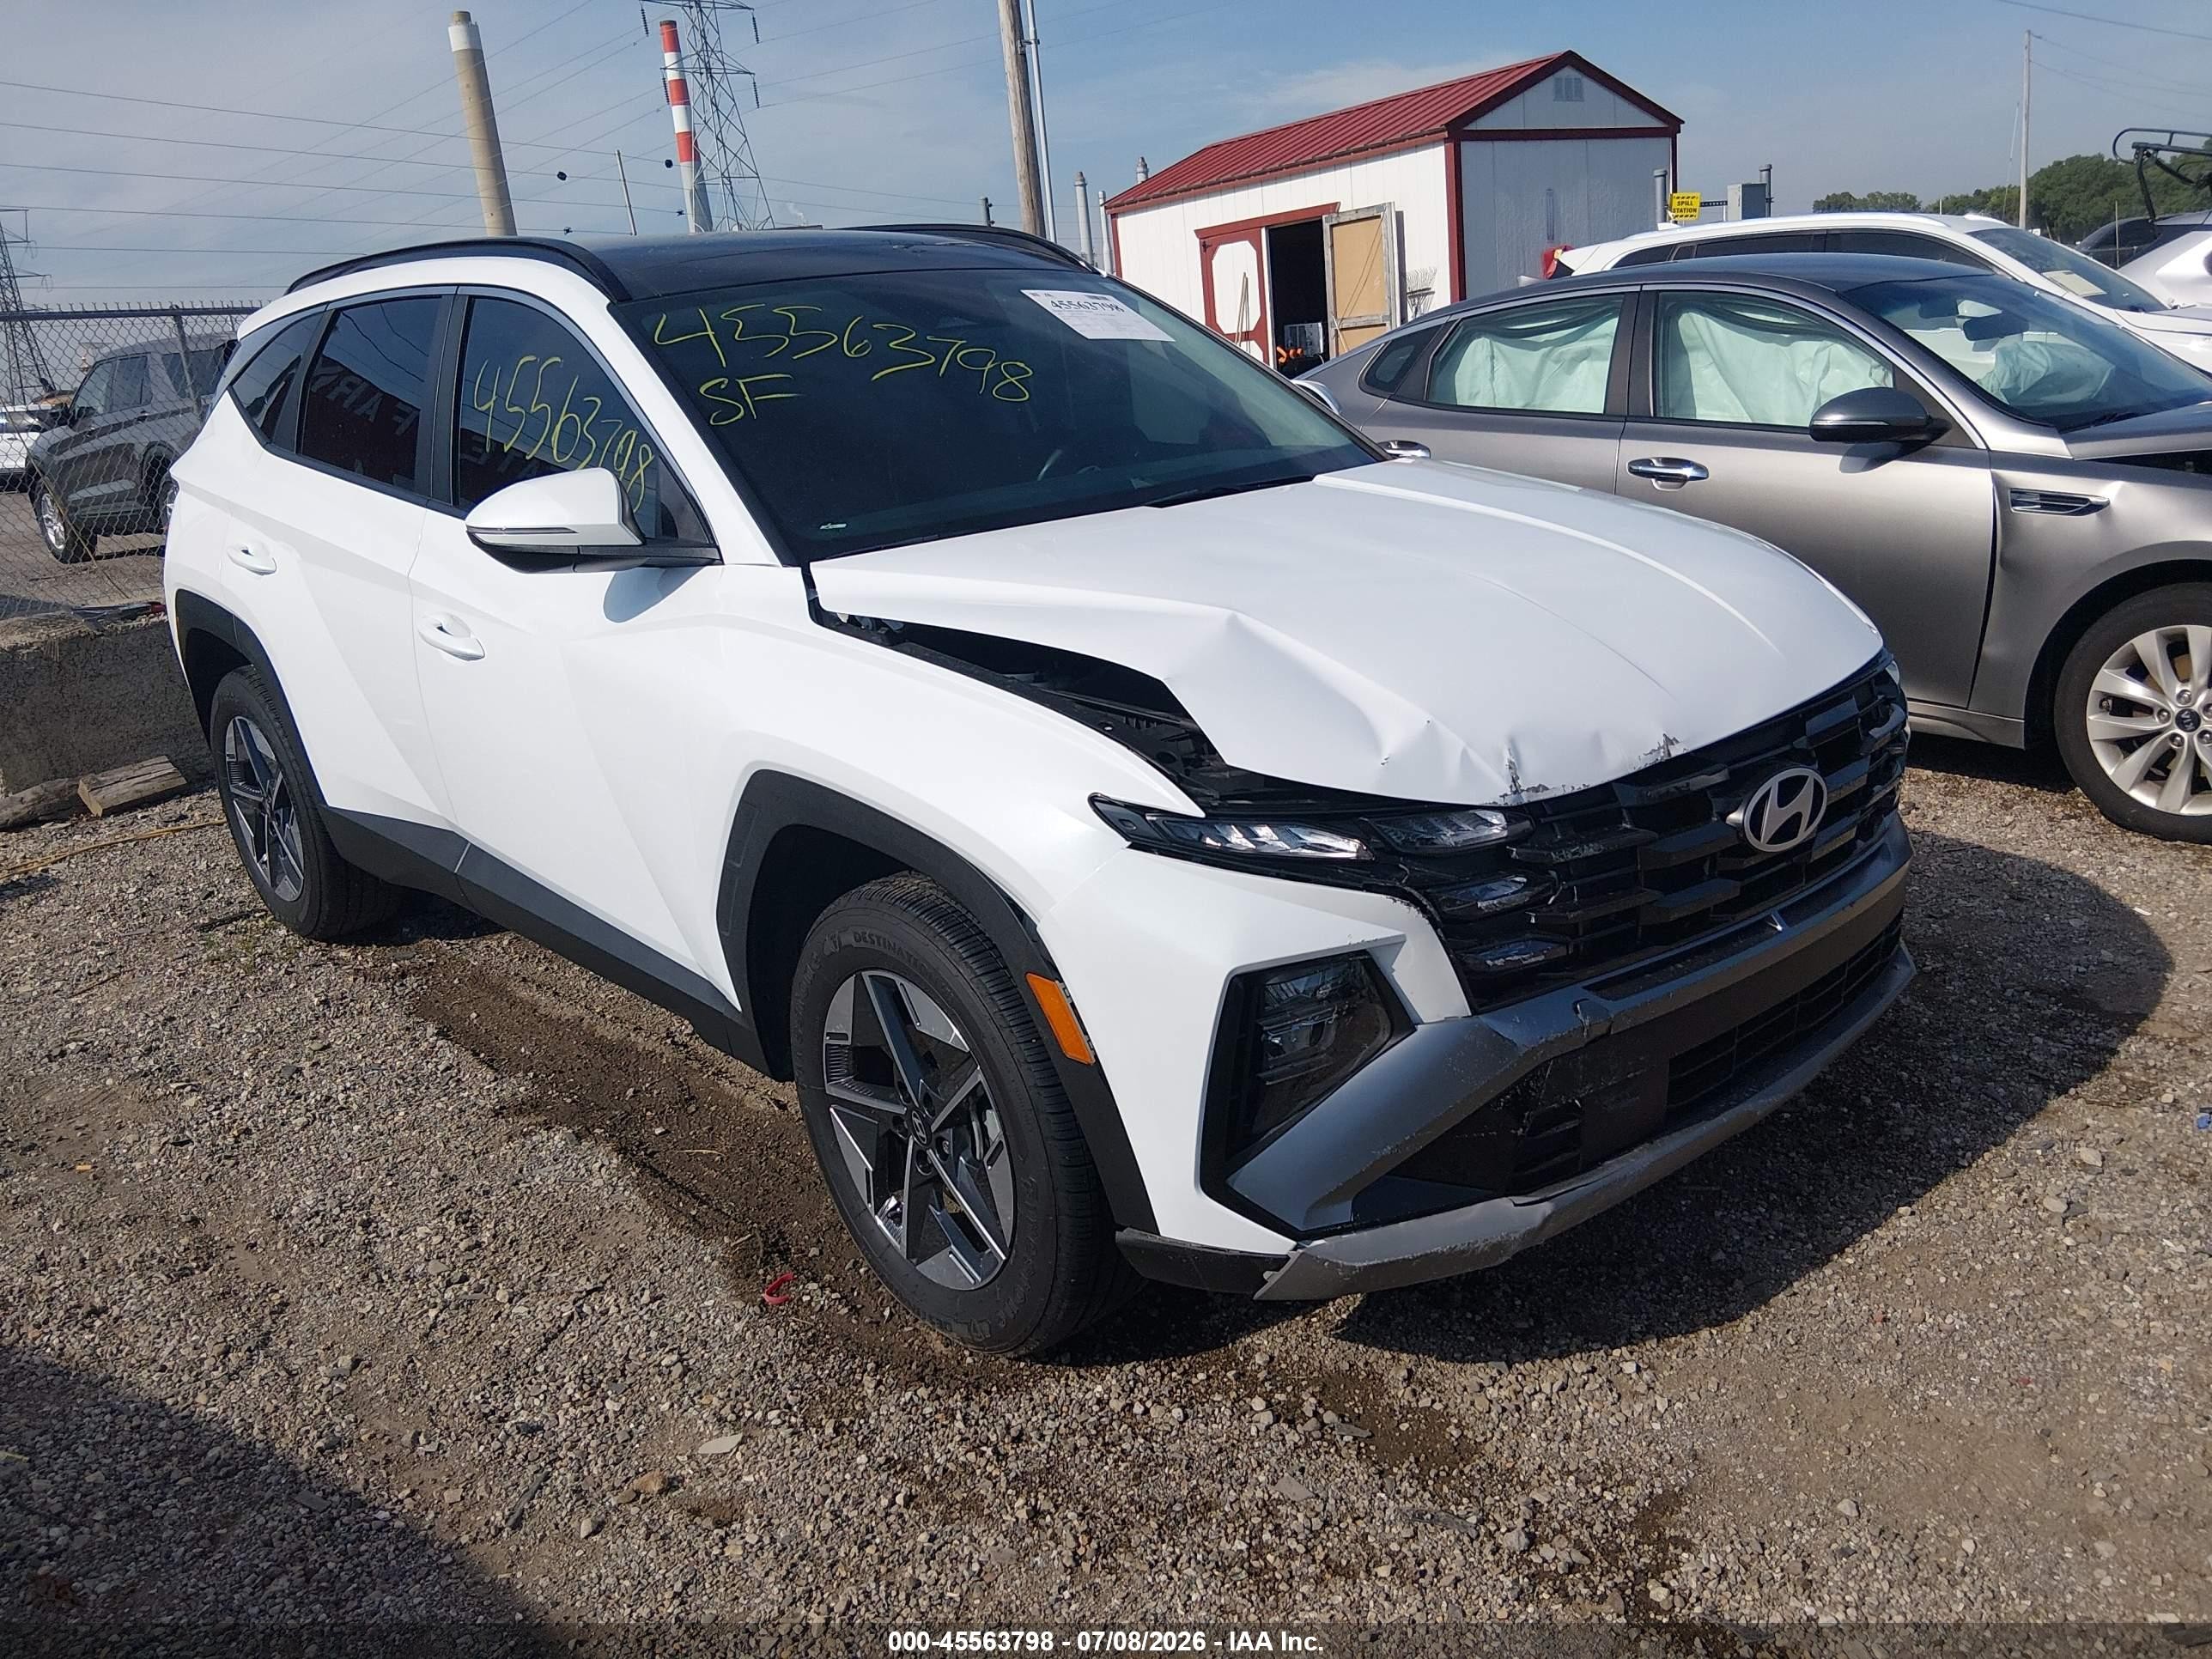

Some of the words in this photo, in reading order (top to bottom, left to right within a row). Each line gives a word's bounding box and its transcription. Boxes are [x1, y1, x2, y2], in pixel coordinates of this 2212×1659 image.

[654, 303, 1034, 403] 45563798
[698, 374, 805, 425] SF
[473, 354, 655, 514] 45563798
